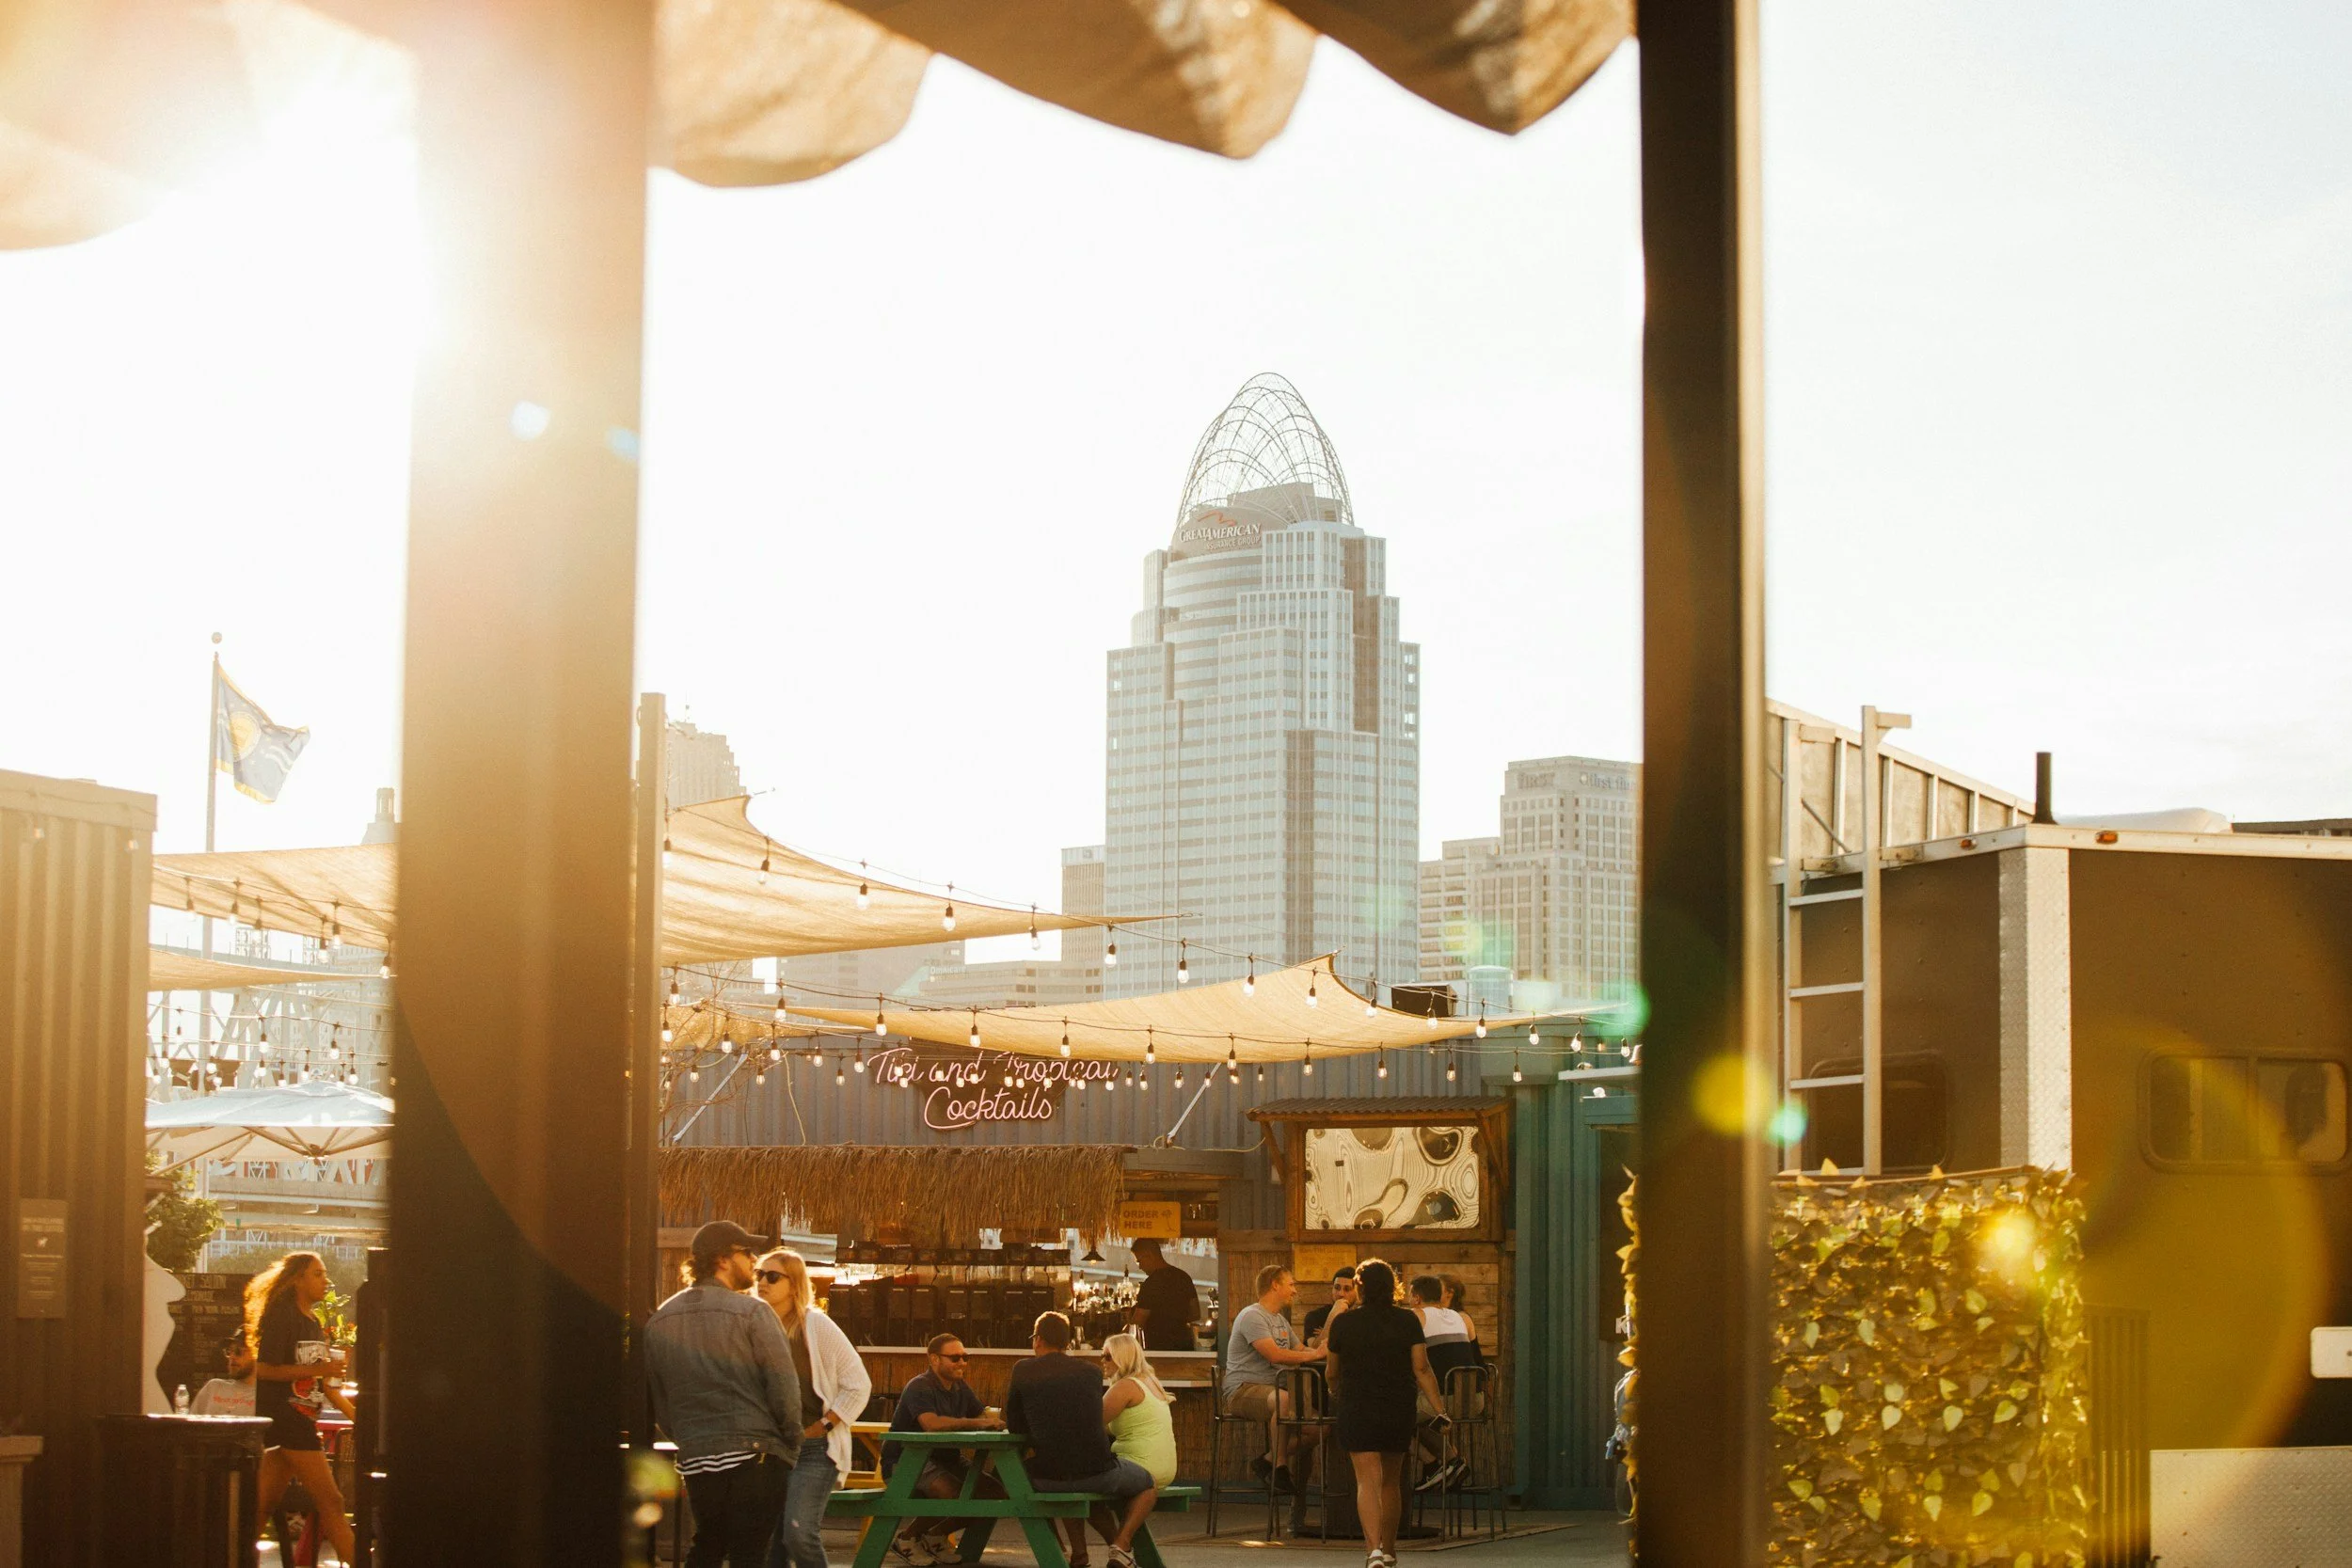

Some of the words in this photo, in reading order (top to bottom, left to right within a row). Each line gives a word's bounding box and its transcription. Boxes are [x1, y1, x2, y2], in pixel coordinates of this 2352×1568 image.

[1237, 535, 1262, 546] GROUP
[929, 1050, 987, 1083] and
[924, 1085, 1053, 1130] Cocktails
[1123, 1210, 1159, 1219] ORDER
[1123, 1221, 1152, 1229] HERE
